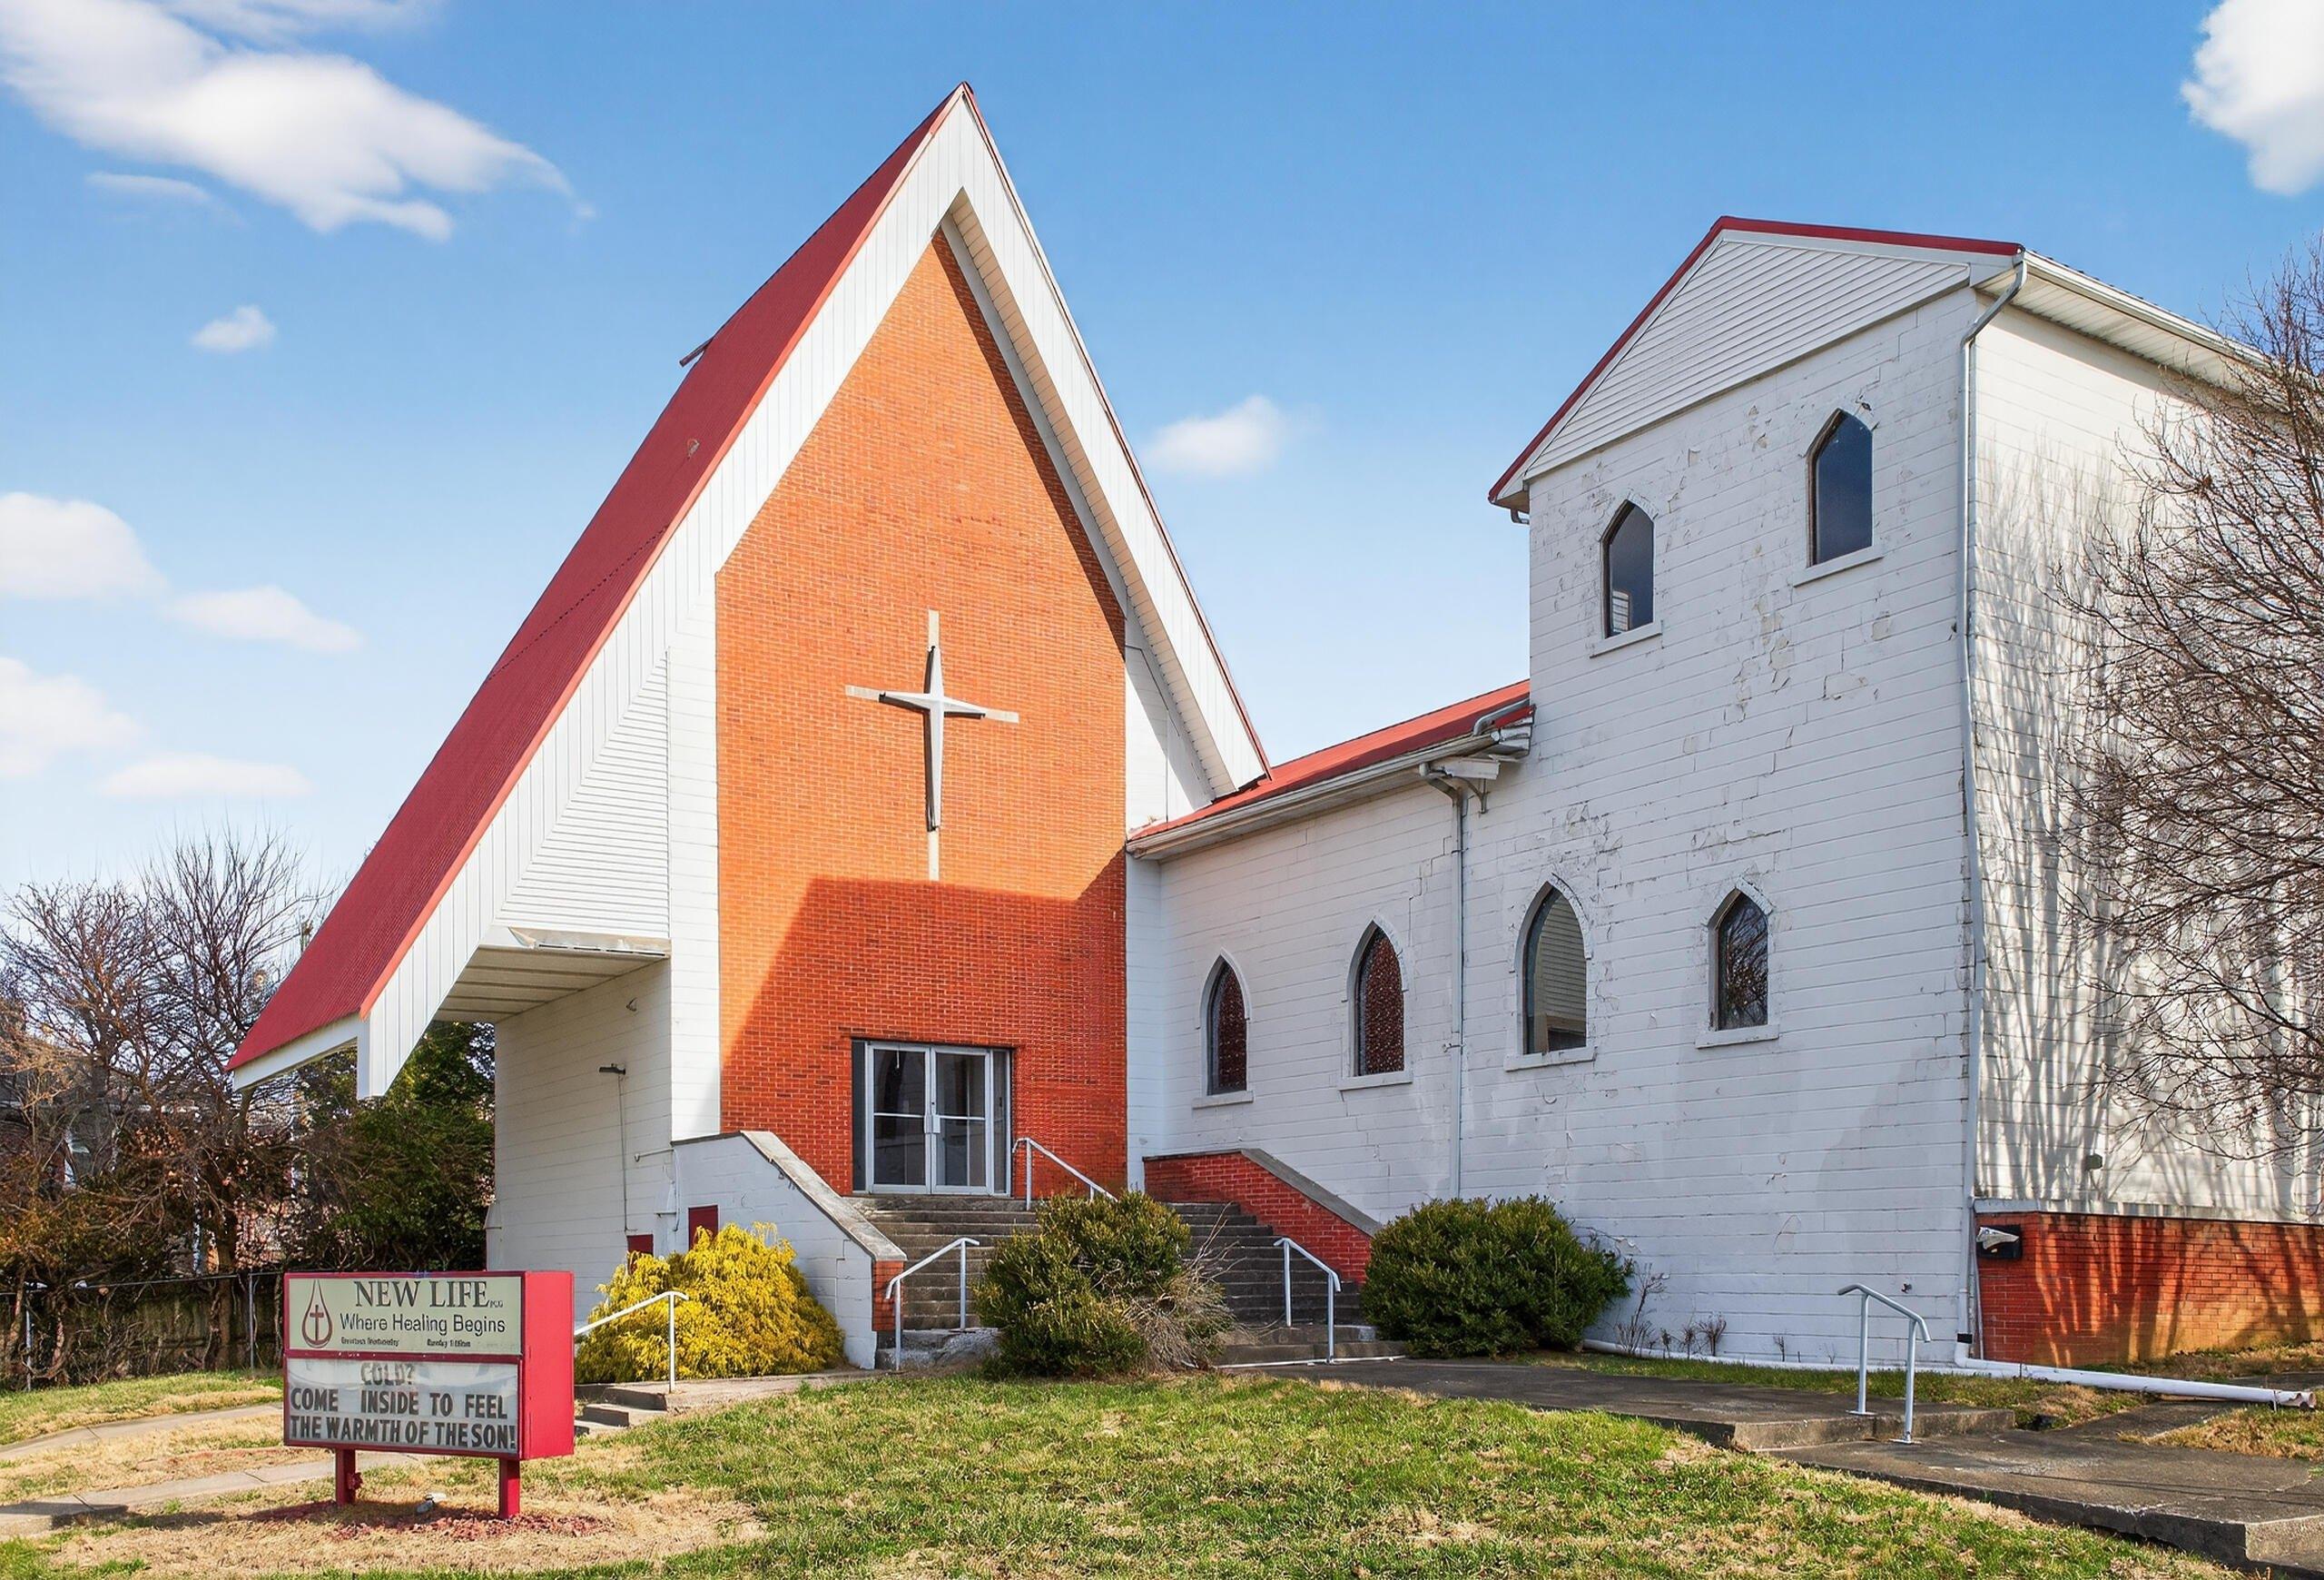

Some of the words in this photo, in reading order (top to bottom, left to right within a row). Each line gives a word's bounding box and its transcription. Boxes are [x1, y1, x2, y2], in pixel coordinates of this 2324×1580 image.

[354, 1280, 420, 1308] NEW
[429, 1281, 489, 1308] LIFE
[340, 1313, 388, 1330] Where
[393, 1314, 447, 1336] Healing
[454, 1315, 506, 1337] Begins
[290, 1387, 339, 1412] COME
[361, 1389, 419, 1416] INSIDE
[429, 1393, 454, 1417] TO
[465, 1394, 507, 1419] FEEL
[290, 1416, 321, 1438] THE
[326, 1417, 400, 1443] WARMTH
[405, 1421, 429, 1446] OF
[435, 1422, 468, 1448] THE
[471, 1425, 517, 1450] SON!
